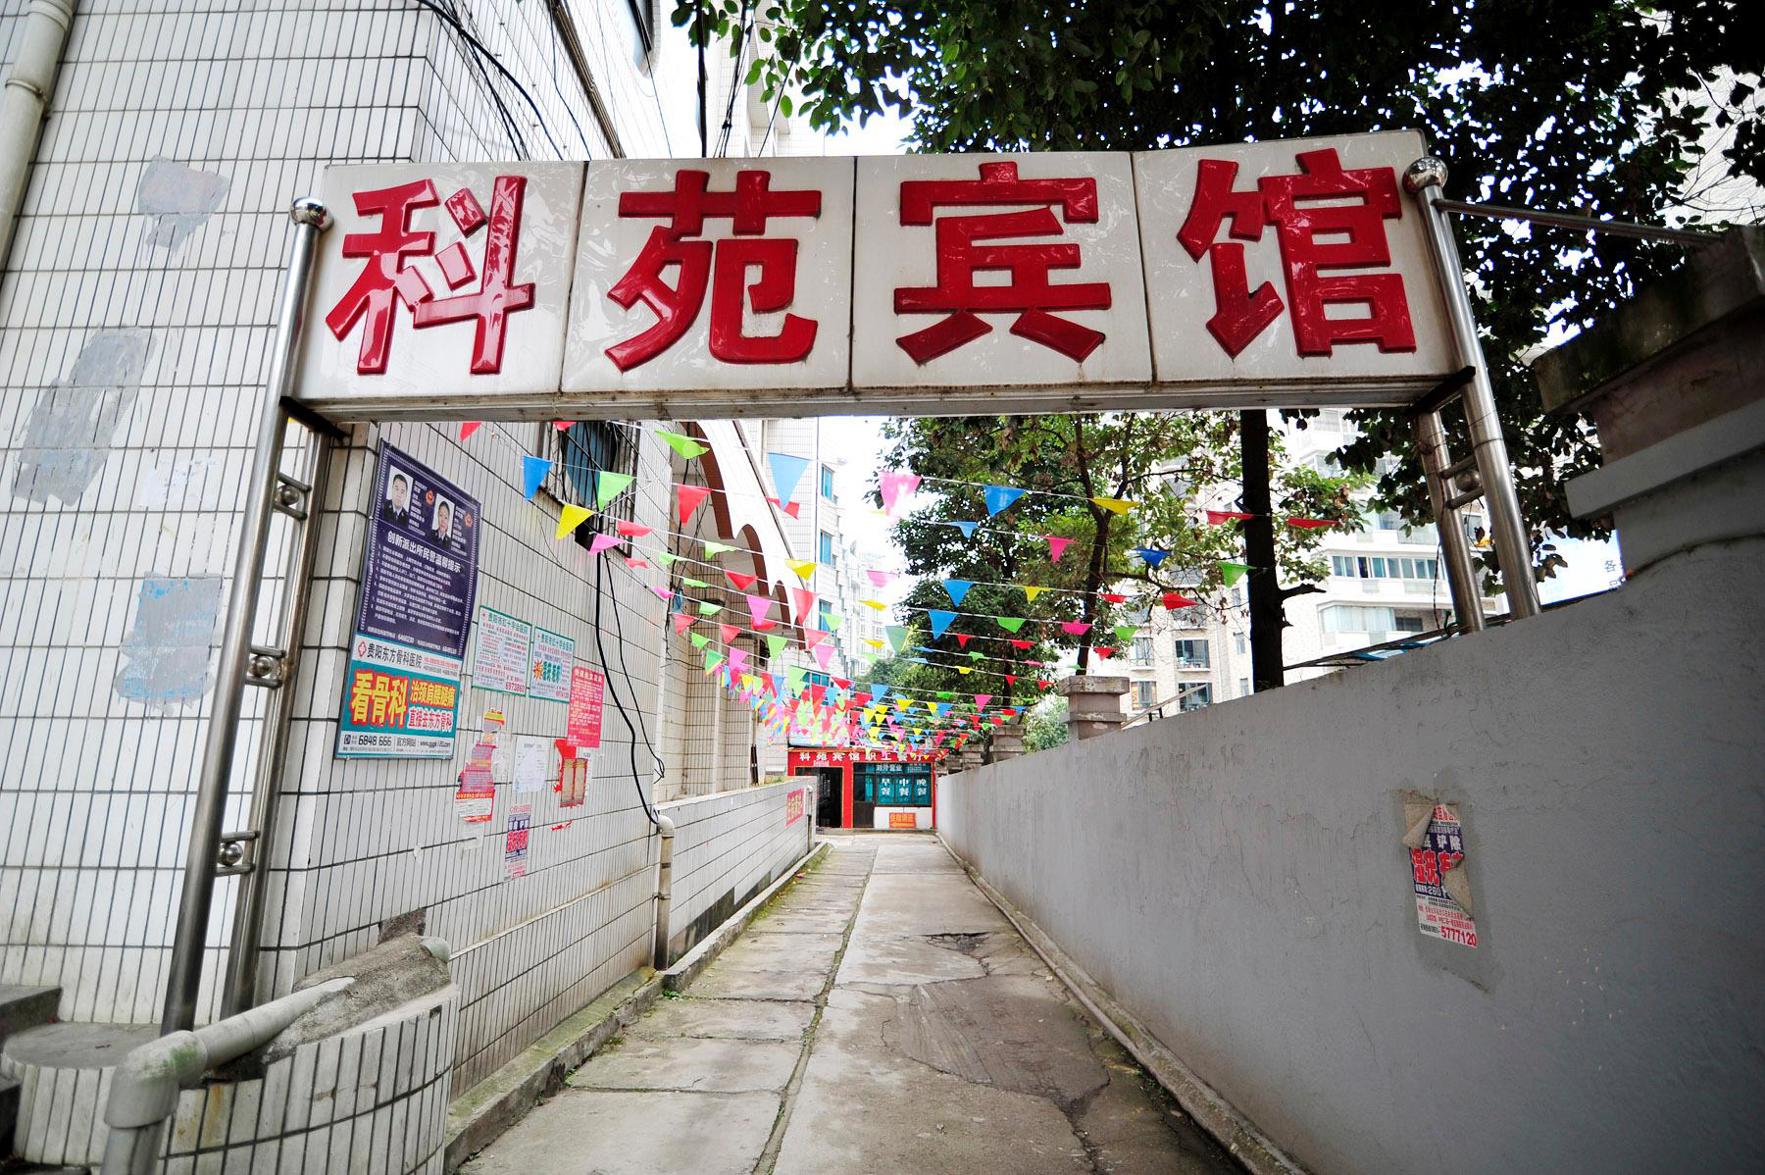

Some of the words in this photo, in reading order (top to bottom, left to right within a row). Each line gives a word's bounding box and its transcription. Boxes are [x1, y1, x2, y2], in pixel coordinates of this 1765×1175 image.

[326, 148, 1417, 375] 科苑宾馆
[387, 530, 462, 573] 创新派出所民警温馨提示
[366, 642, 423, 669] 贵阳东方骨科医院
[351, 672, 408, 726] 看骨科
[1440, 925, 1477, 947] 5777120
